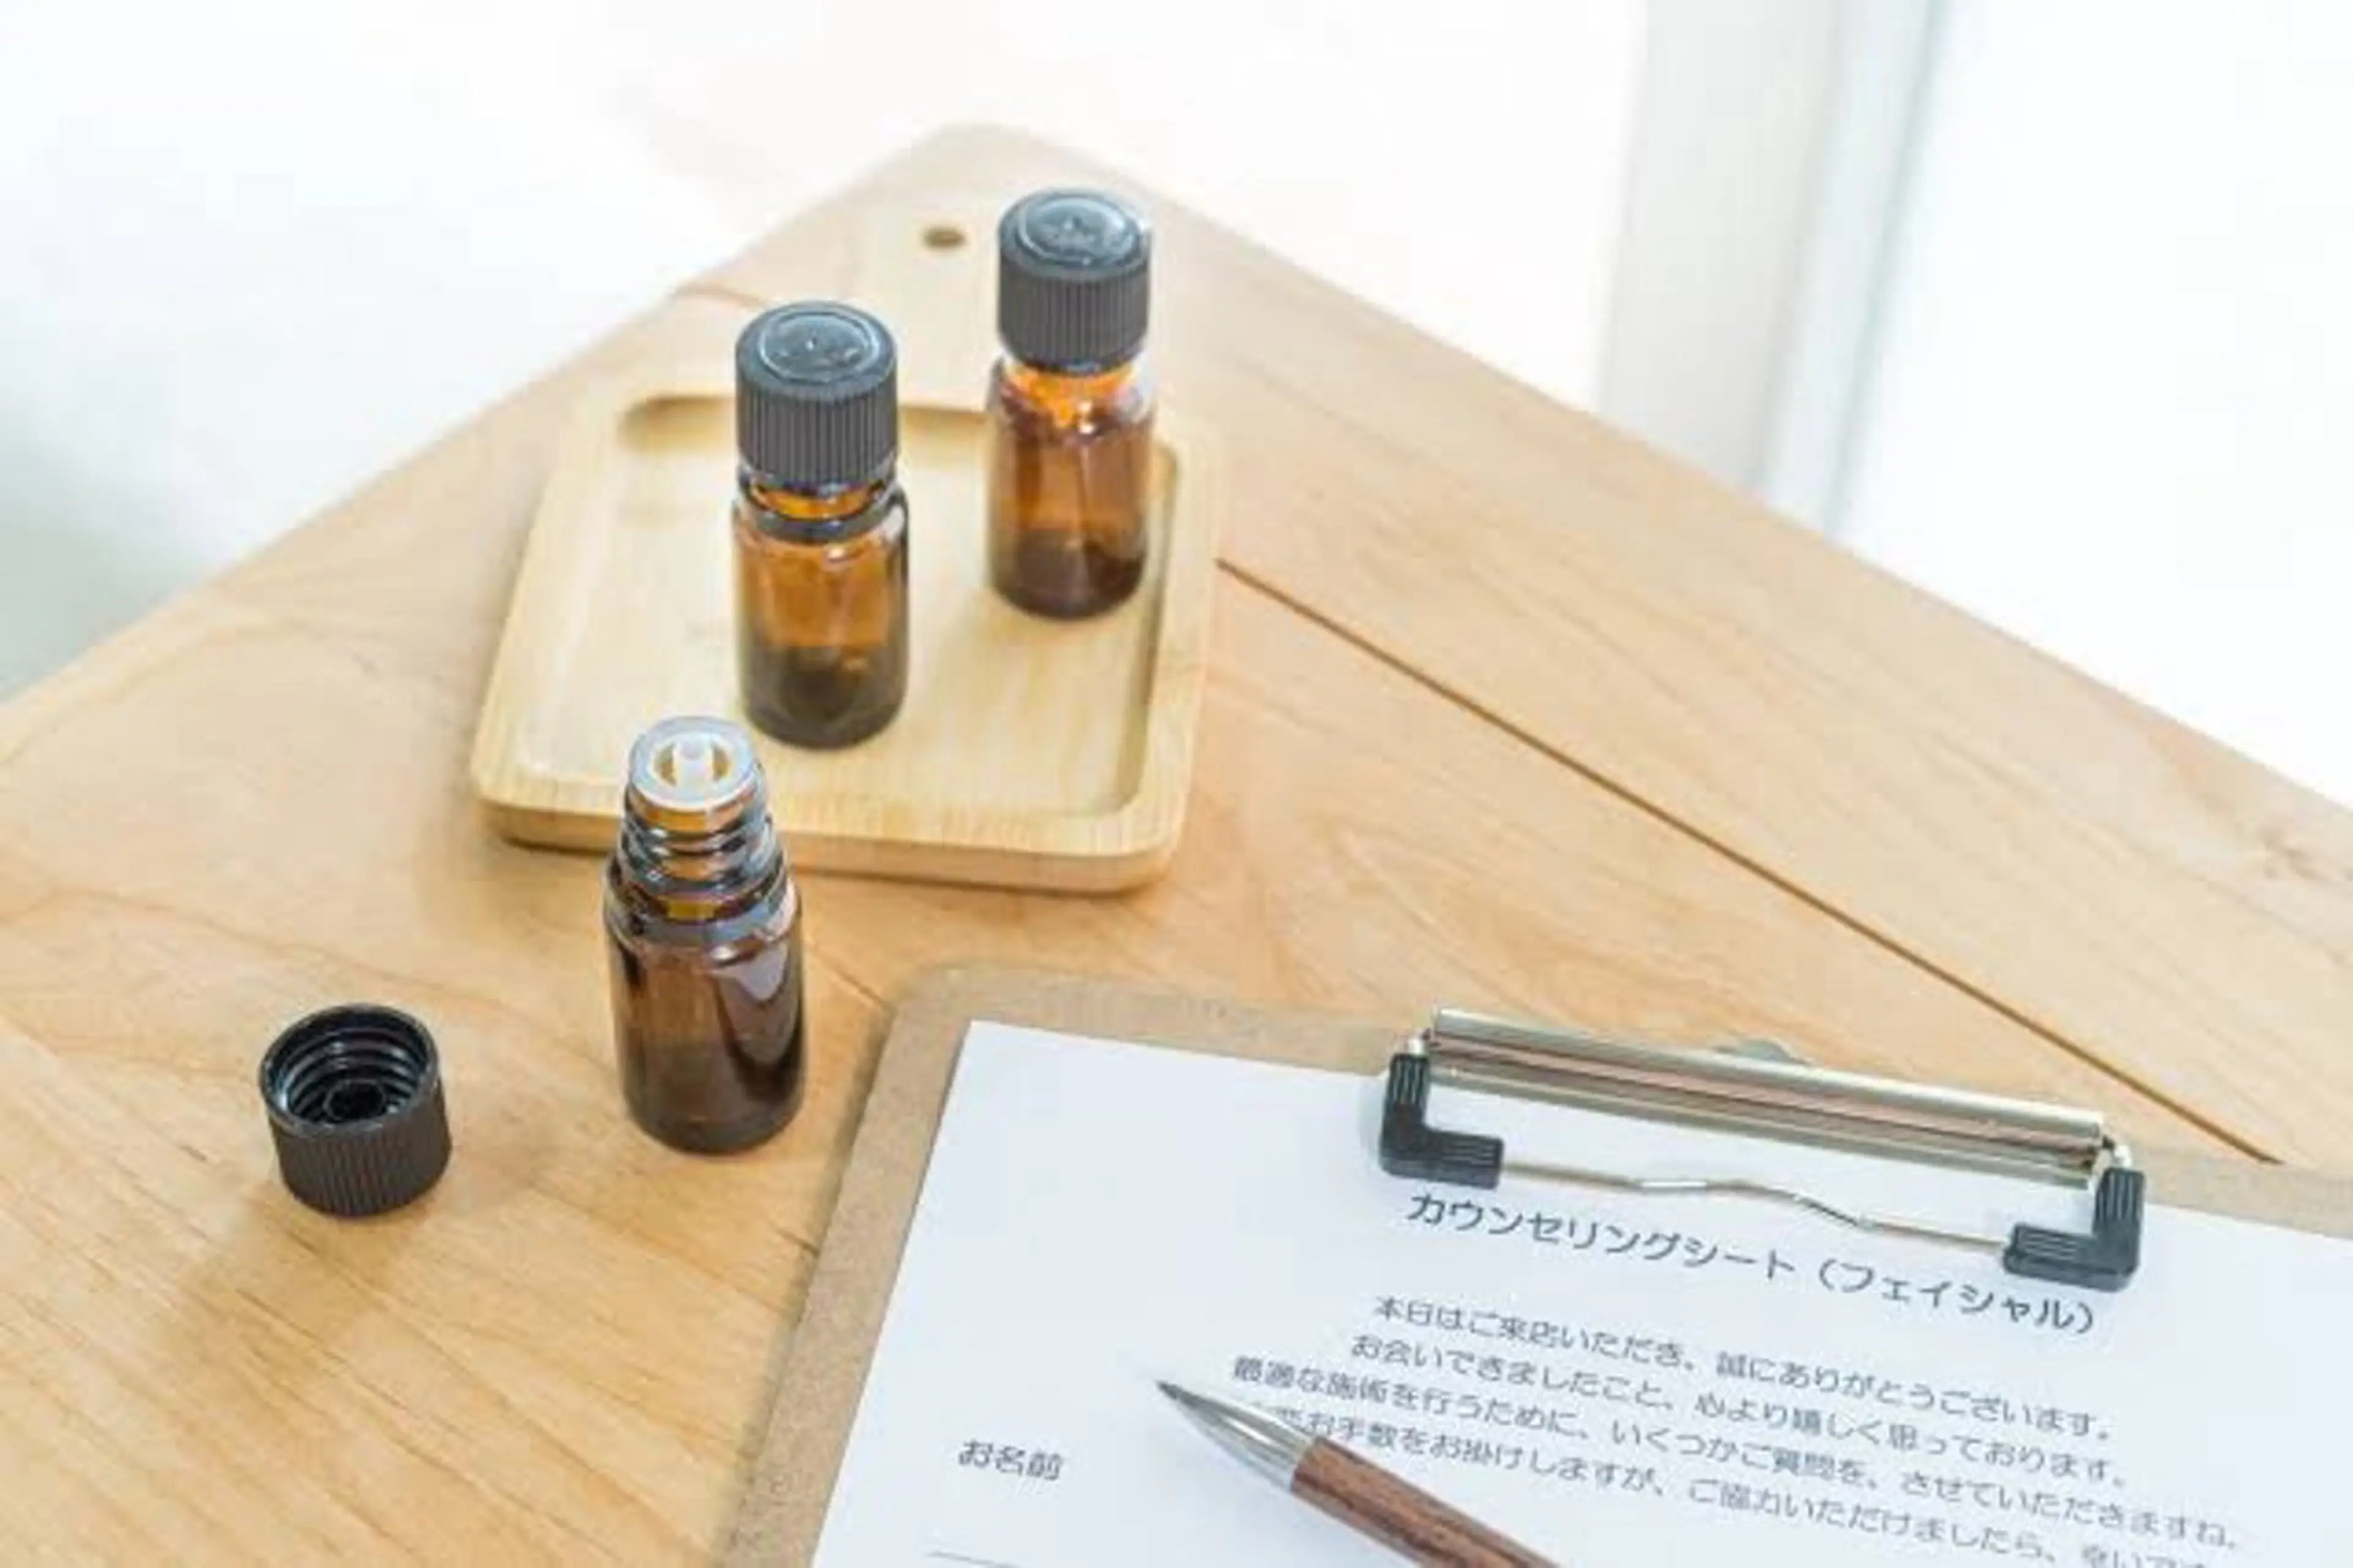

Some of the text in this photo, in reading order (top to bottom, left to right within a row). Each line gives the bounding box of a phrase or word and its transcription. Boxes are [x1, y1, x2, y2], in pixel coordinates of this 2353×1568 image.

[1407, 1193, 2094, 1333] カウンセリングシート（フェイシャル）
[1351, 1335, 2126, 1487] お会いできましたこと、心より嬉しく思っております。
[1376, 1295, 2110, 1441] 本日はご来店いただき、誠にありがとうございます。
[958, 1439, 1063, 1480] お名前
